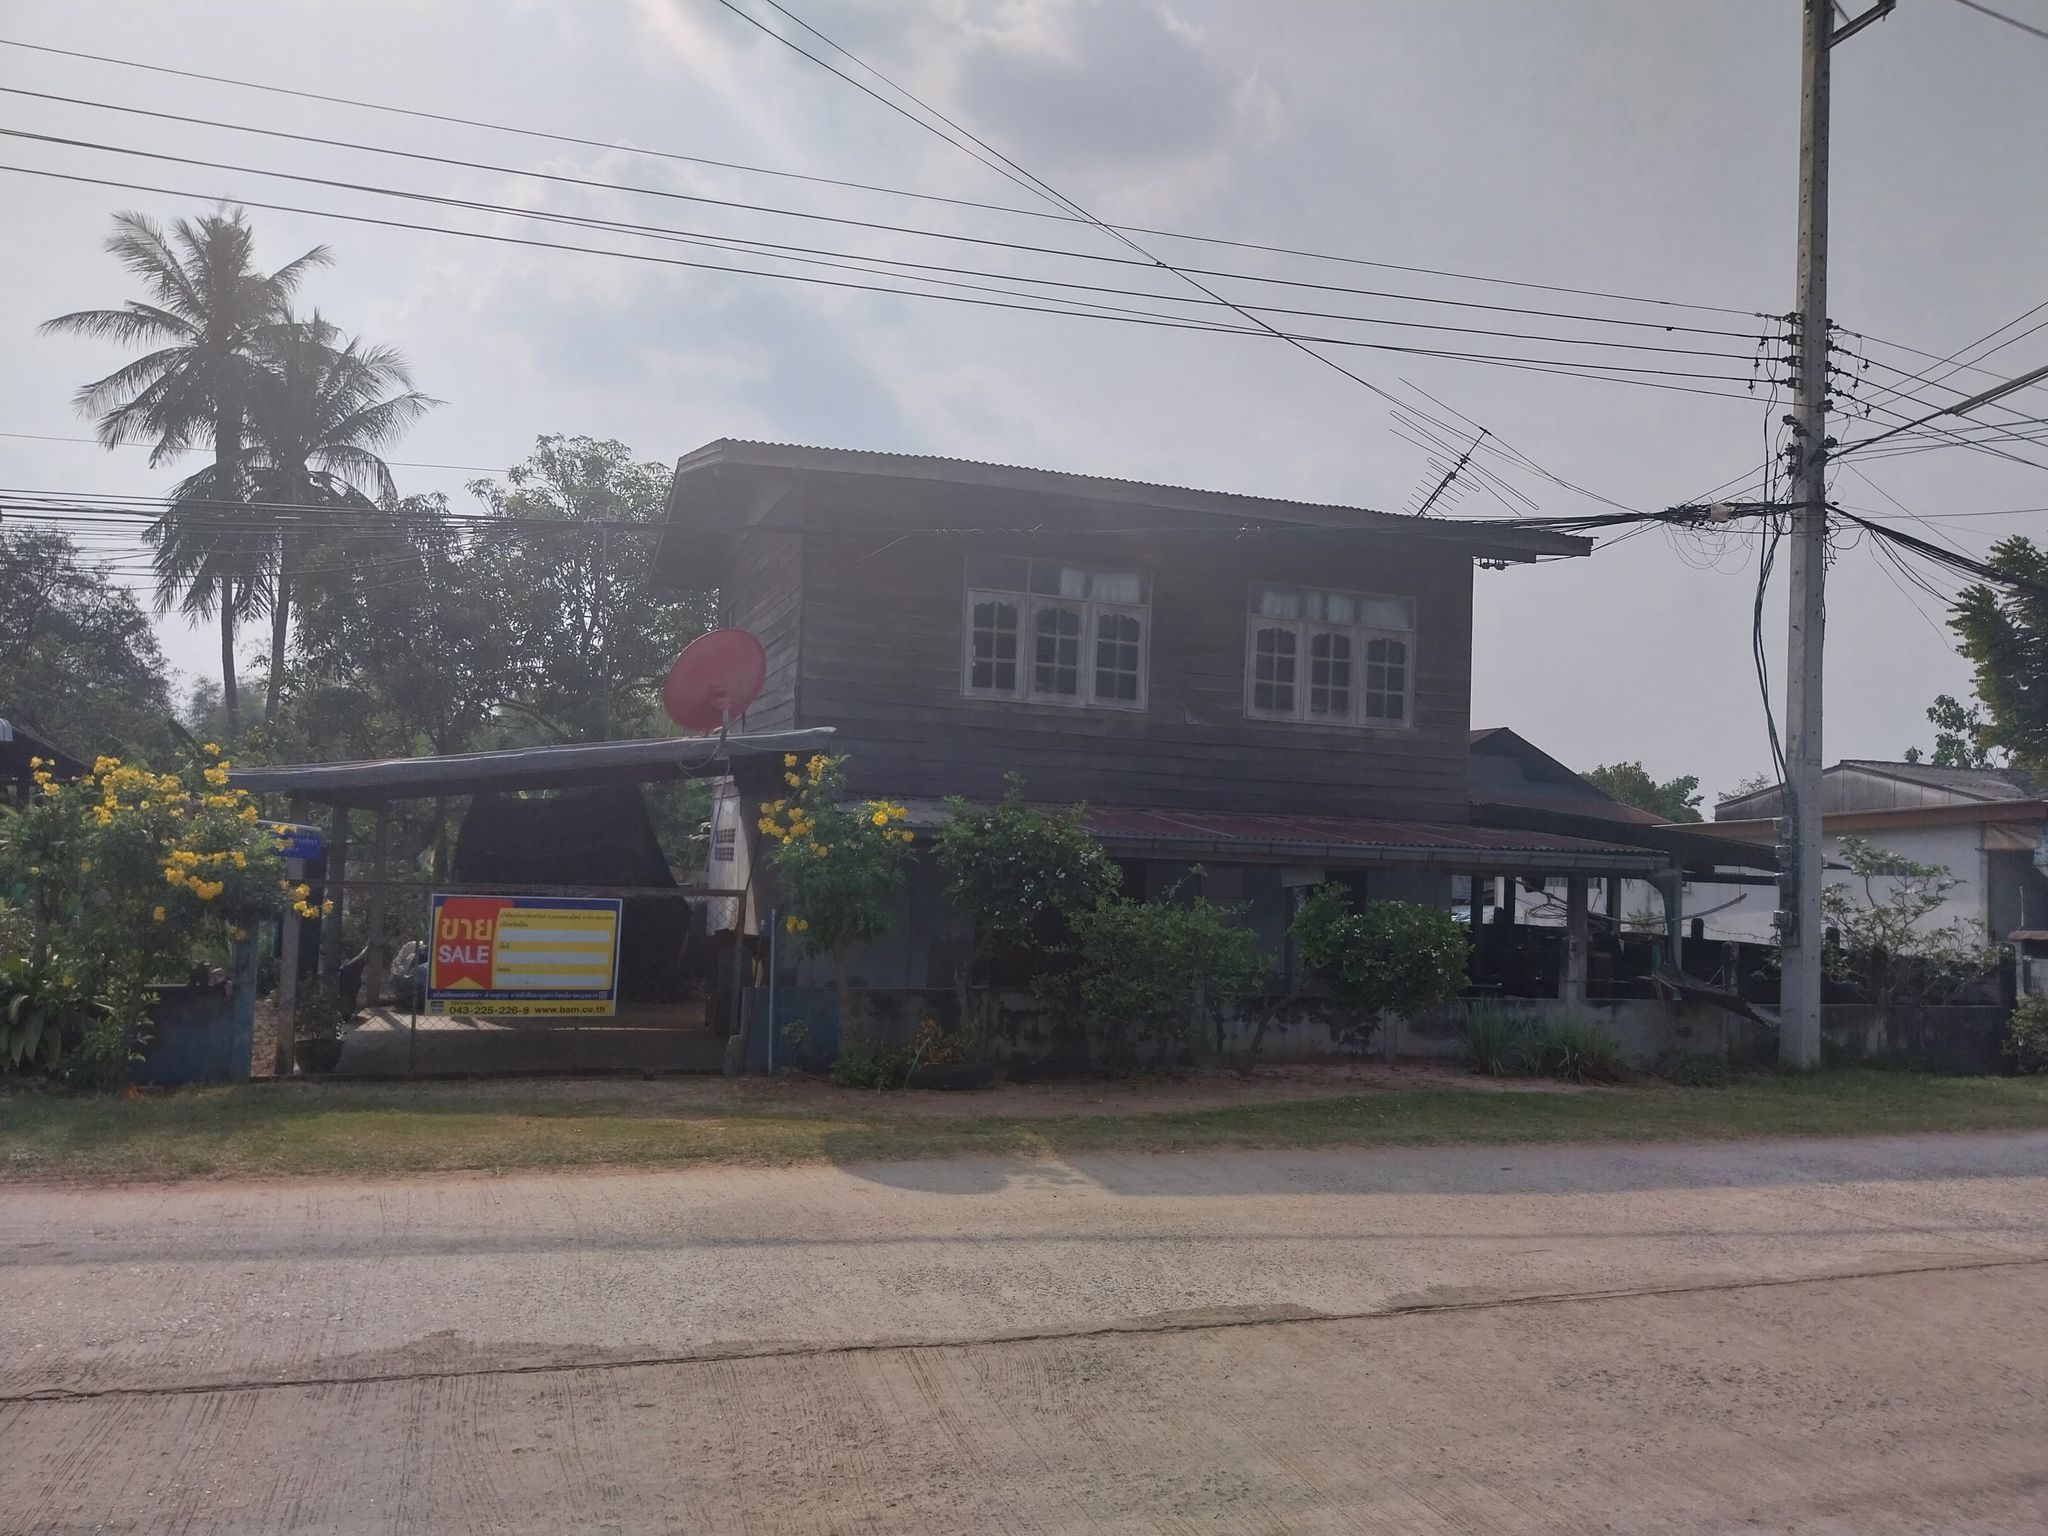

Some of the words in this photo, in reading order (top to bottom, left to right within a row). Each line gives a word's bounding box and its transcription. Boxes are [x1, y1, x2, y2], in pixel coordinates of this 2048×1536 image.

[441, 918, 493, 941] ขาย
[438, 945, 489, 964] SALE
[449, 1005, 530, 1015] 043-225-226-8
[534, 1004, 605, 1014] www.bam.co.th
